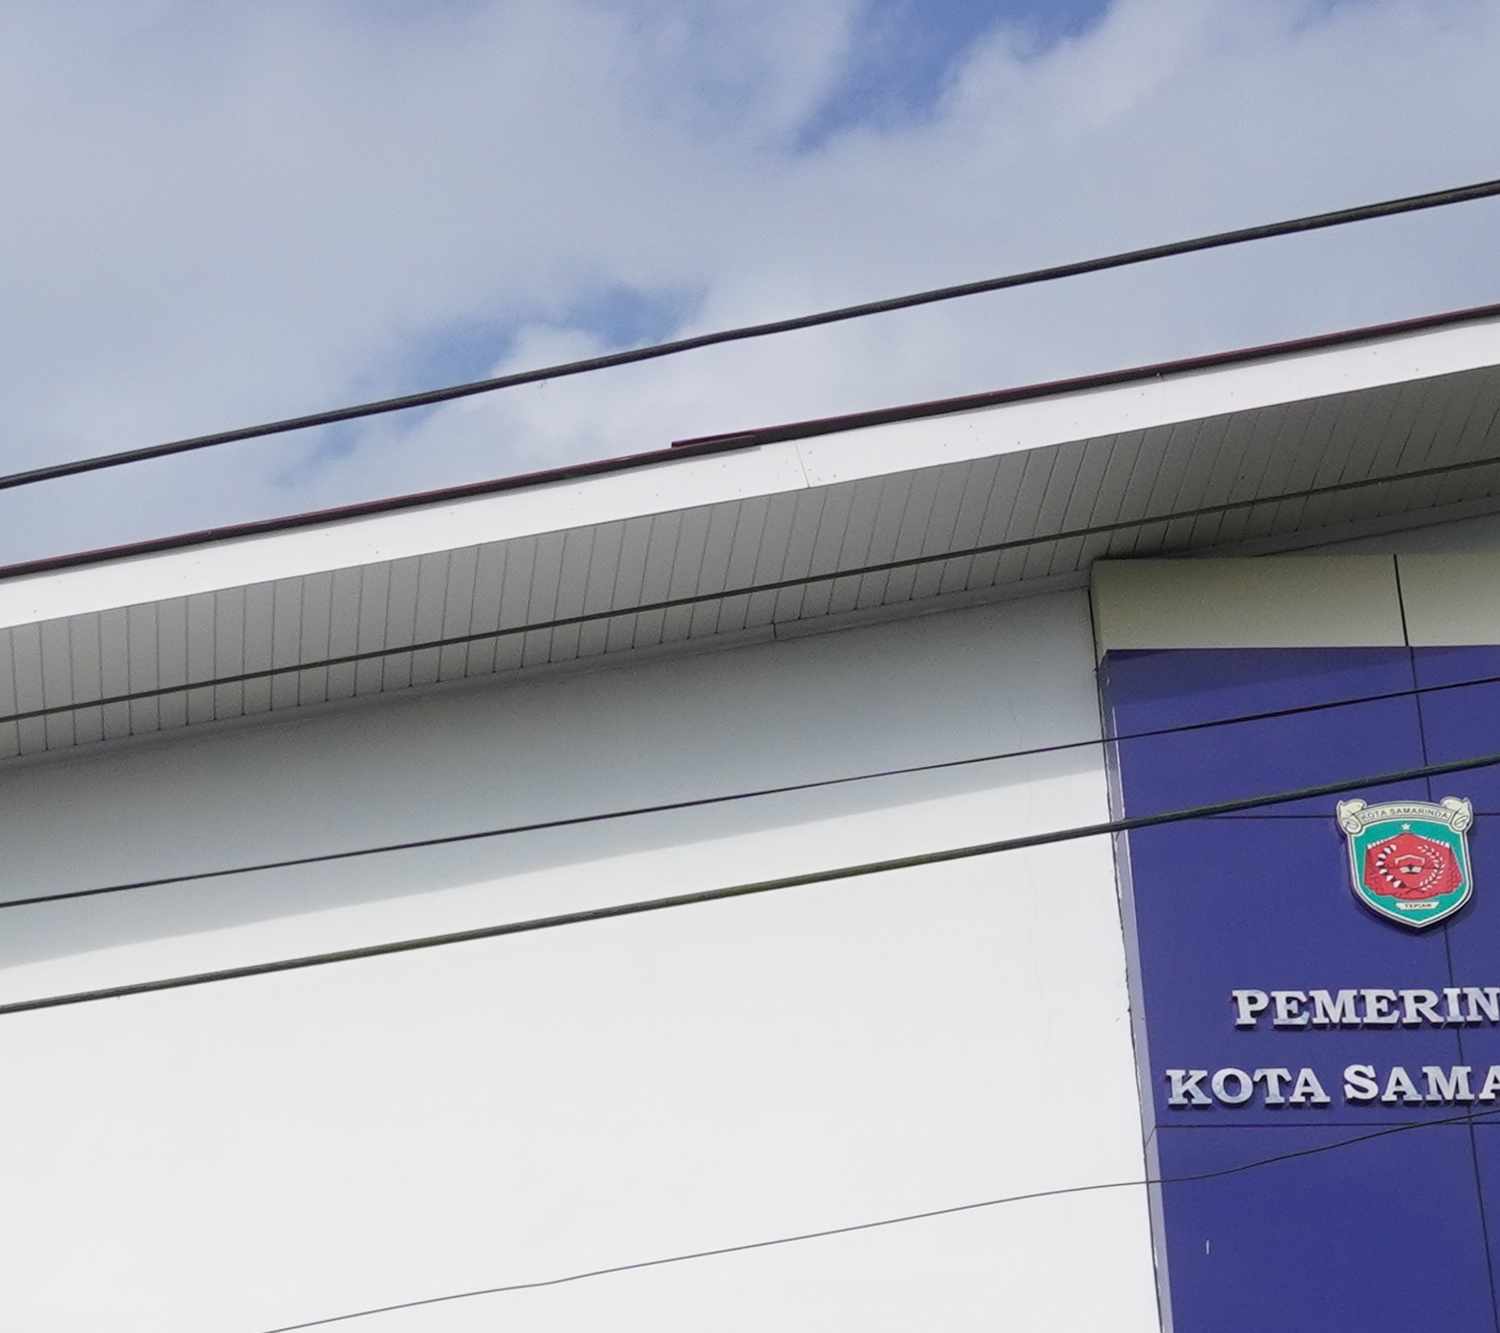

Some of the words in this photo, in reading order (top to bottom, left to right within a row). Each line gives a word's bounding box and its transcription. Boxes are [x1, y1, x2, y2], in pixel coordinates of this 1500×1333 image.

[1361, 809, 1386, 820] KOTA
[1390, 806, 1448, 818] SAMARINDA
[1166, 1067, 1331, 1105] KOTA
